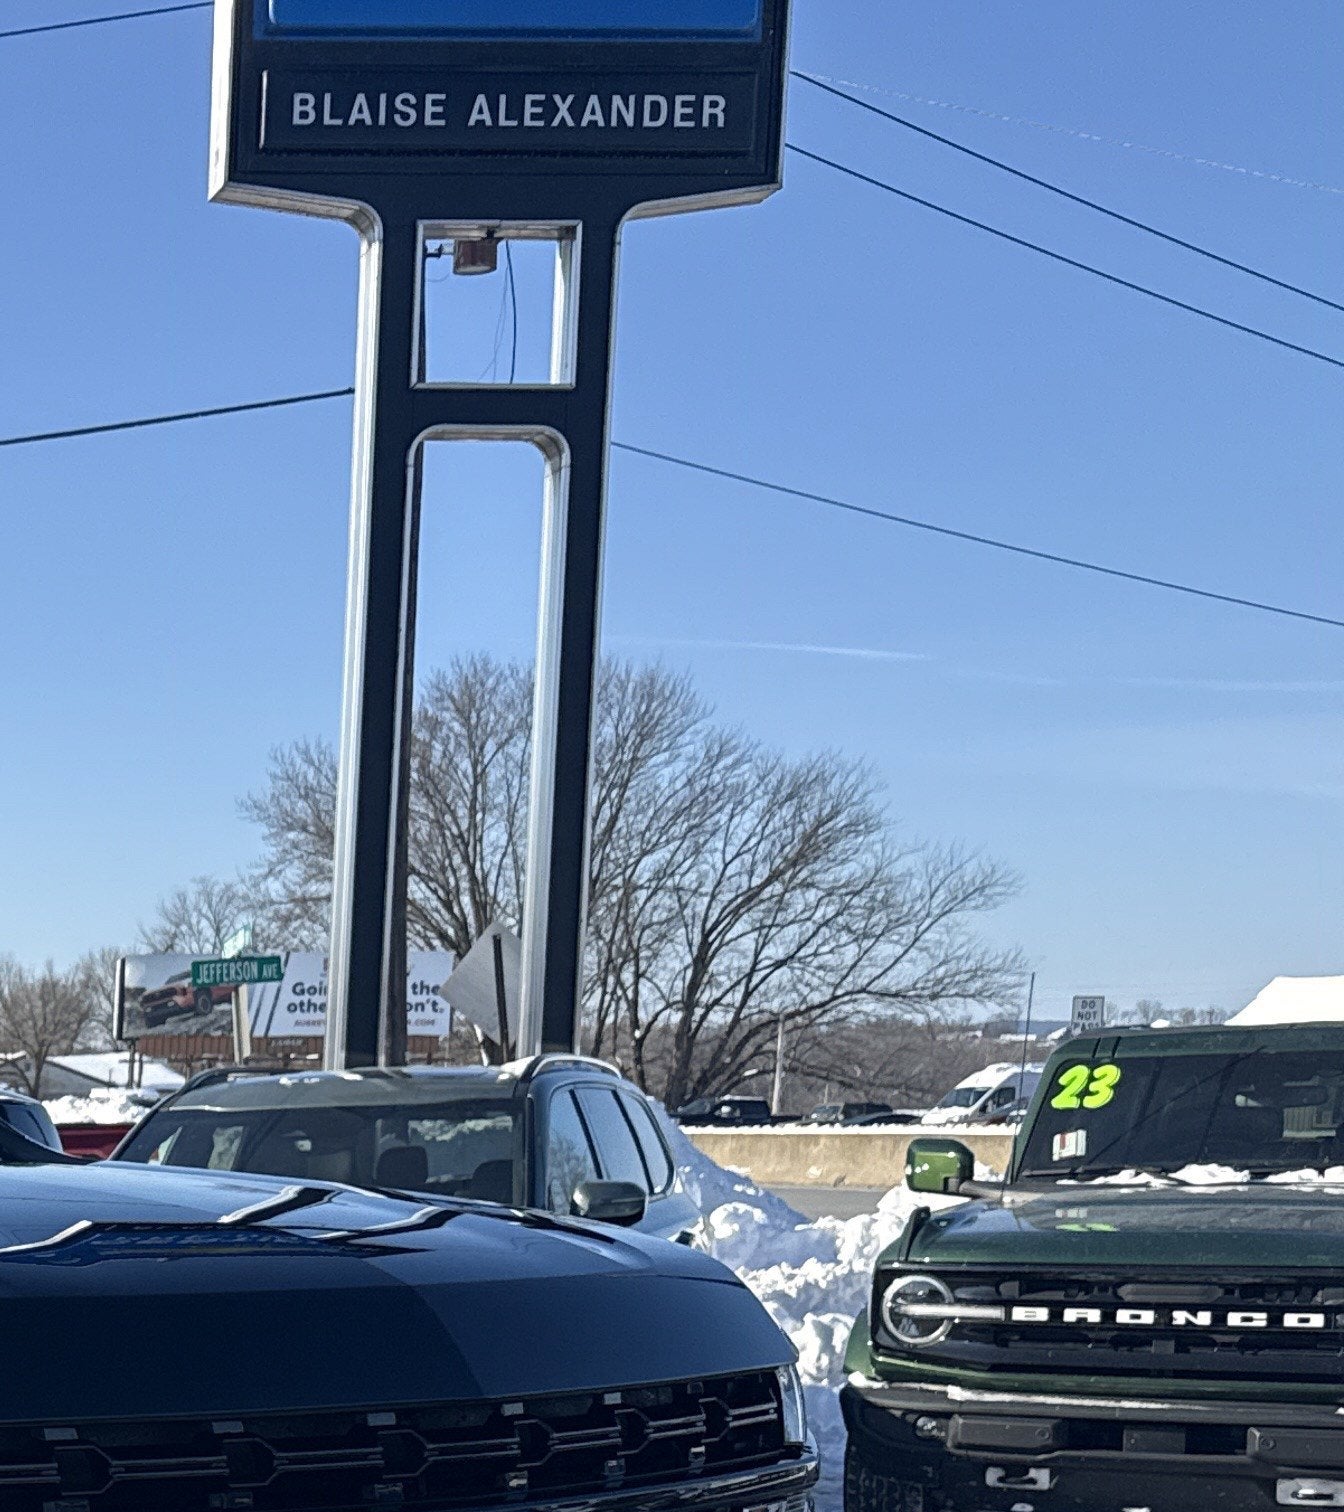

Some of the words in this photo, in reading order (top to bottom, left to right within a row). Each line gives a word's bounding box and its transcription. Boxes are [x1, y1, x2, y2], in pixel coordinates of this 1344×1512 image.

[291, 92, 447, 127] BLAISE
[467, 93, 727, 128] ALEXANDER
[196, 961, 259, 983] JEFFERSON
[262, 963, 279, 979] AVE
[287, 999, 327, 1014] othe
[1077, 1011, 1098, 1020] NOT
[1081, 1000, 1096, 1010] DO
[1051, 1064, 1121, 1110] 23
[1011, 1305, 1325, 1329] BRONCO
